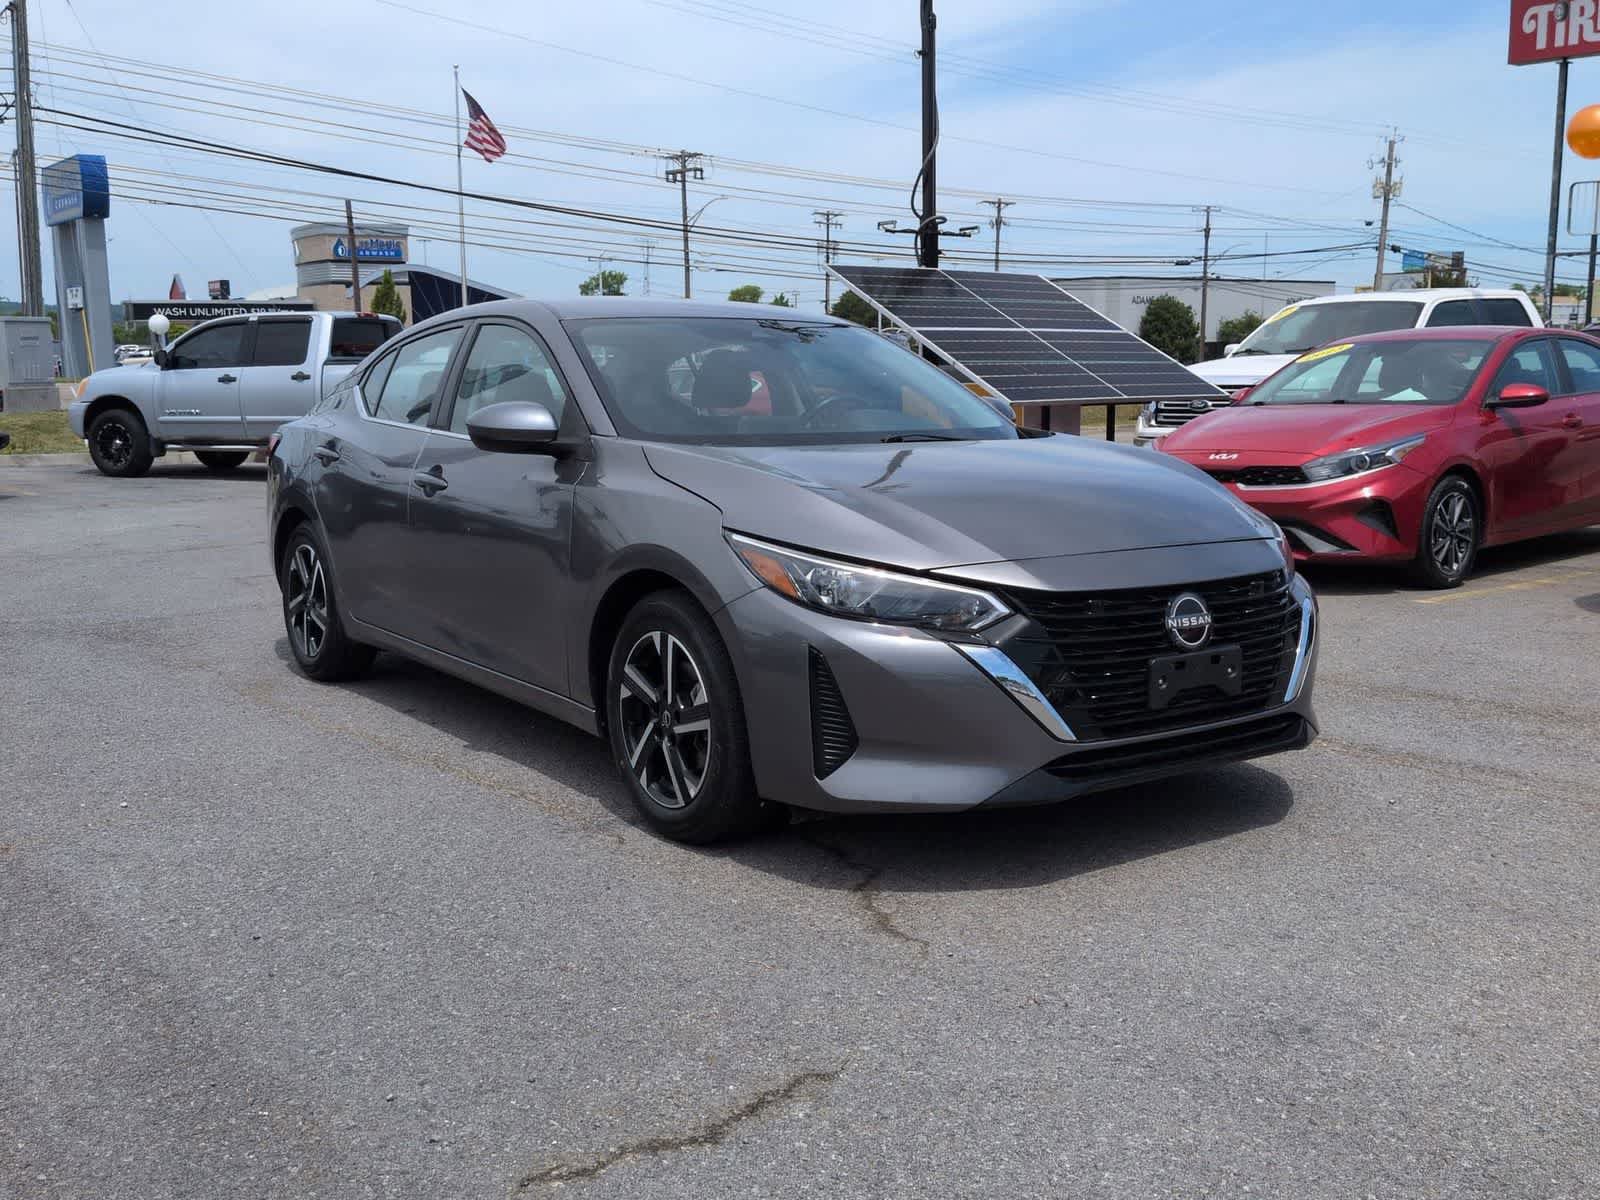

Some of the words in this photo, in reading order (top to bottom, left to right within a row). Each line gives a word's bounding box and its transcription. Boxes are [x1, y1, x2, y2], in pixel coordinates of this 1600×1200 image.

[153, 307, 187, 316] WASH
[189, 307, 247, 317] UNLIMITED
[1168, 615, 1212, 629] NISSAN
